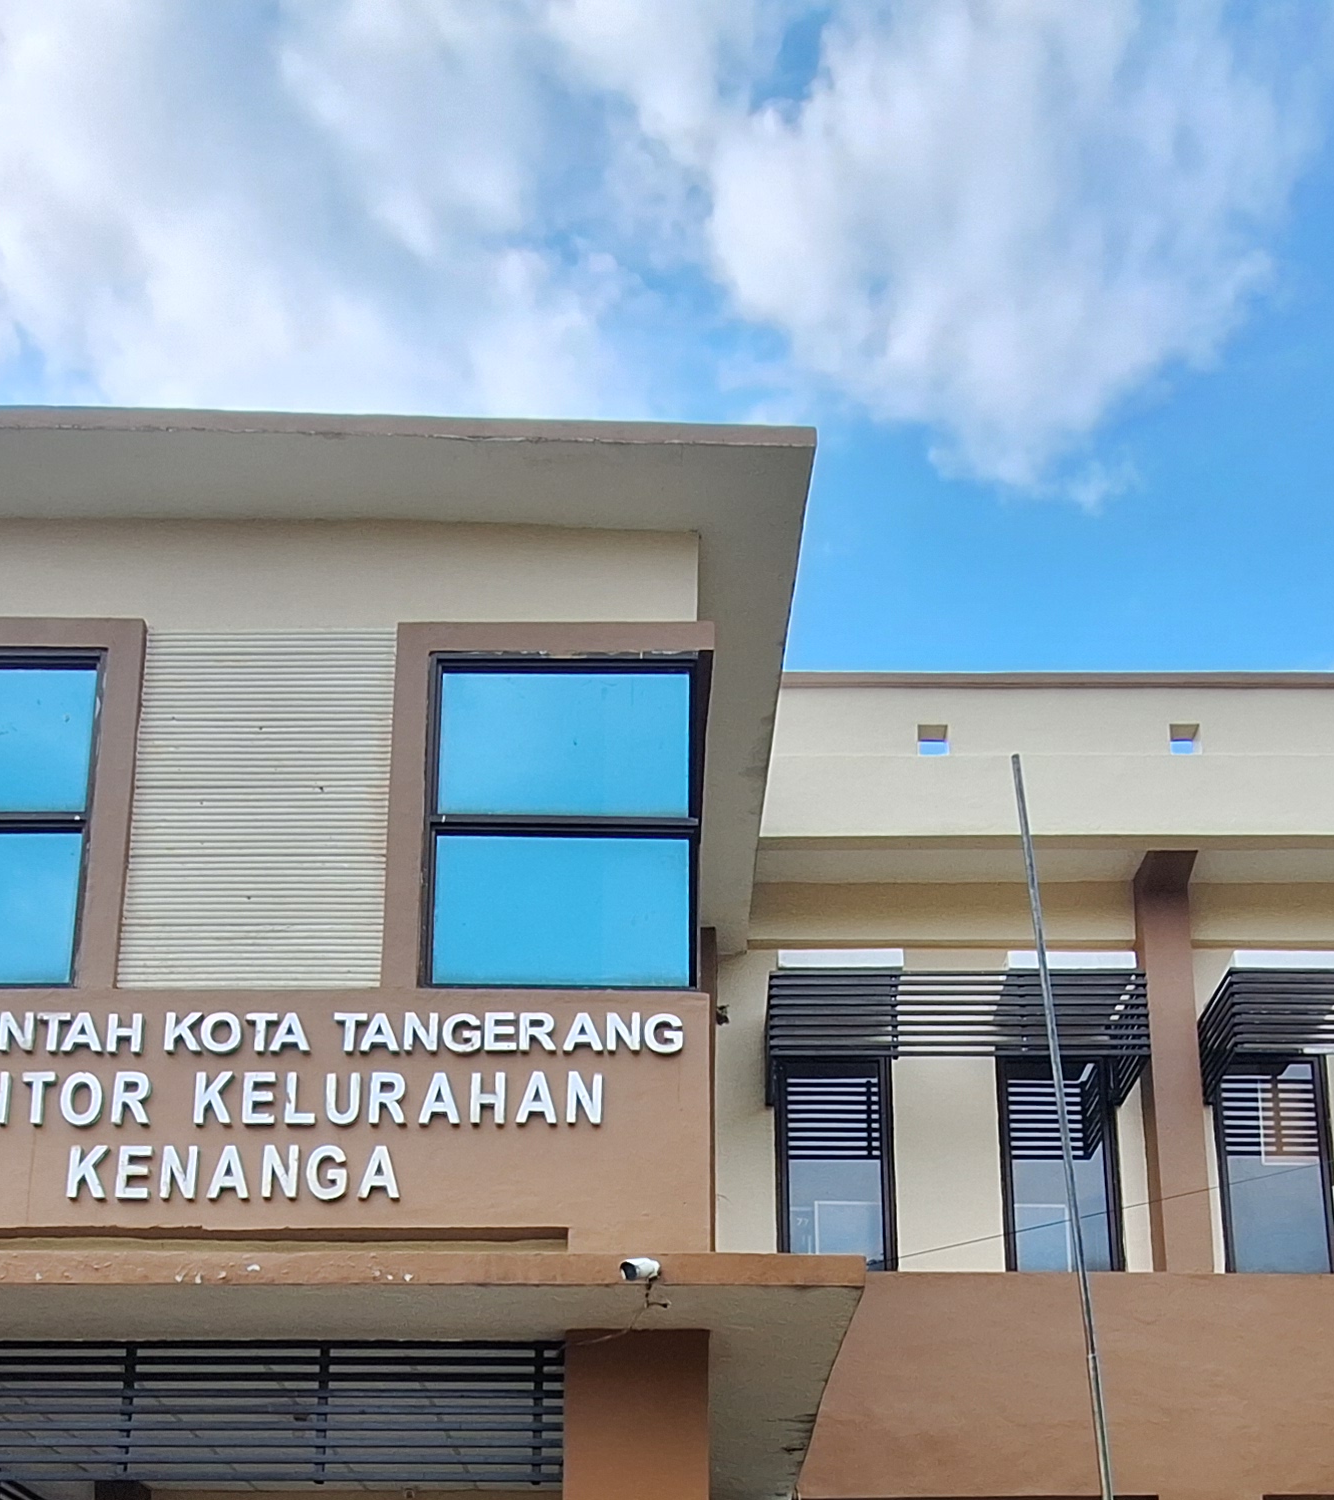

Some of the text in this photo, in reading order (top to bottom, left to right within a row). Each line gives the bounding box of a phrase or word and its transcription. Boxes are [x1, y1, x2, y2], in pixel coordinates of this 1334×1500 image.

[162, 1011, 311, 1056] KOTA
[333, 1011, 685, 1057] TANGERANG
[193, 1070, 606, 1127] KELURAHAN
[66, 1144, 400, 1201] KENANGA
